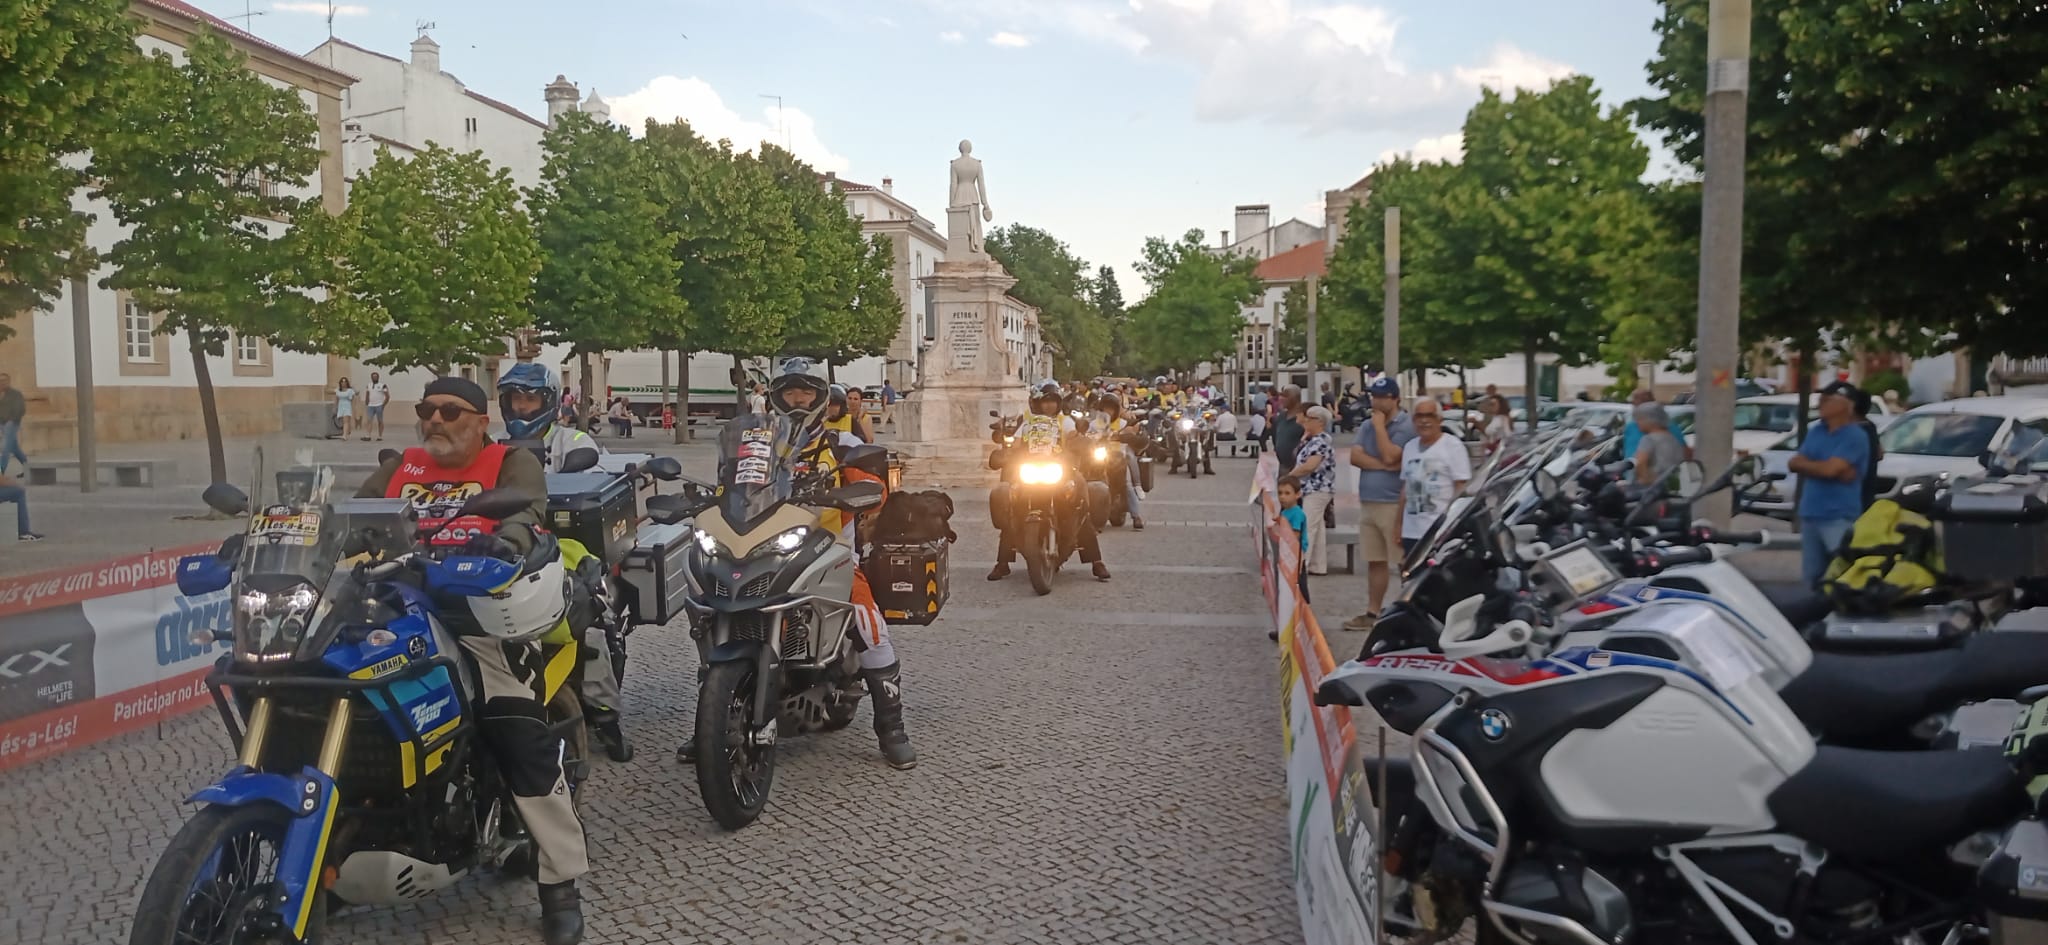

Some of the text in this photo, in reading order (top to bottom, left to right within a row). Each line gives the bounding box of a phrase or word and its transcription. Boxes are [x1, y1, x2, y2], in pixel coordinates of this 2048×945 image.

[23, 577, 59, 606] que
[64, 572, 92, 590] um
[371, 656, 403, 676] YAMAHA
[37, 681, 73, 697] HELMETS
[56, 690, 73, 704] LIFE
[113, 689, 177, 722] Participar
[178, 685, 192, 703] no
